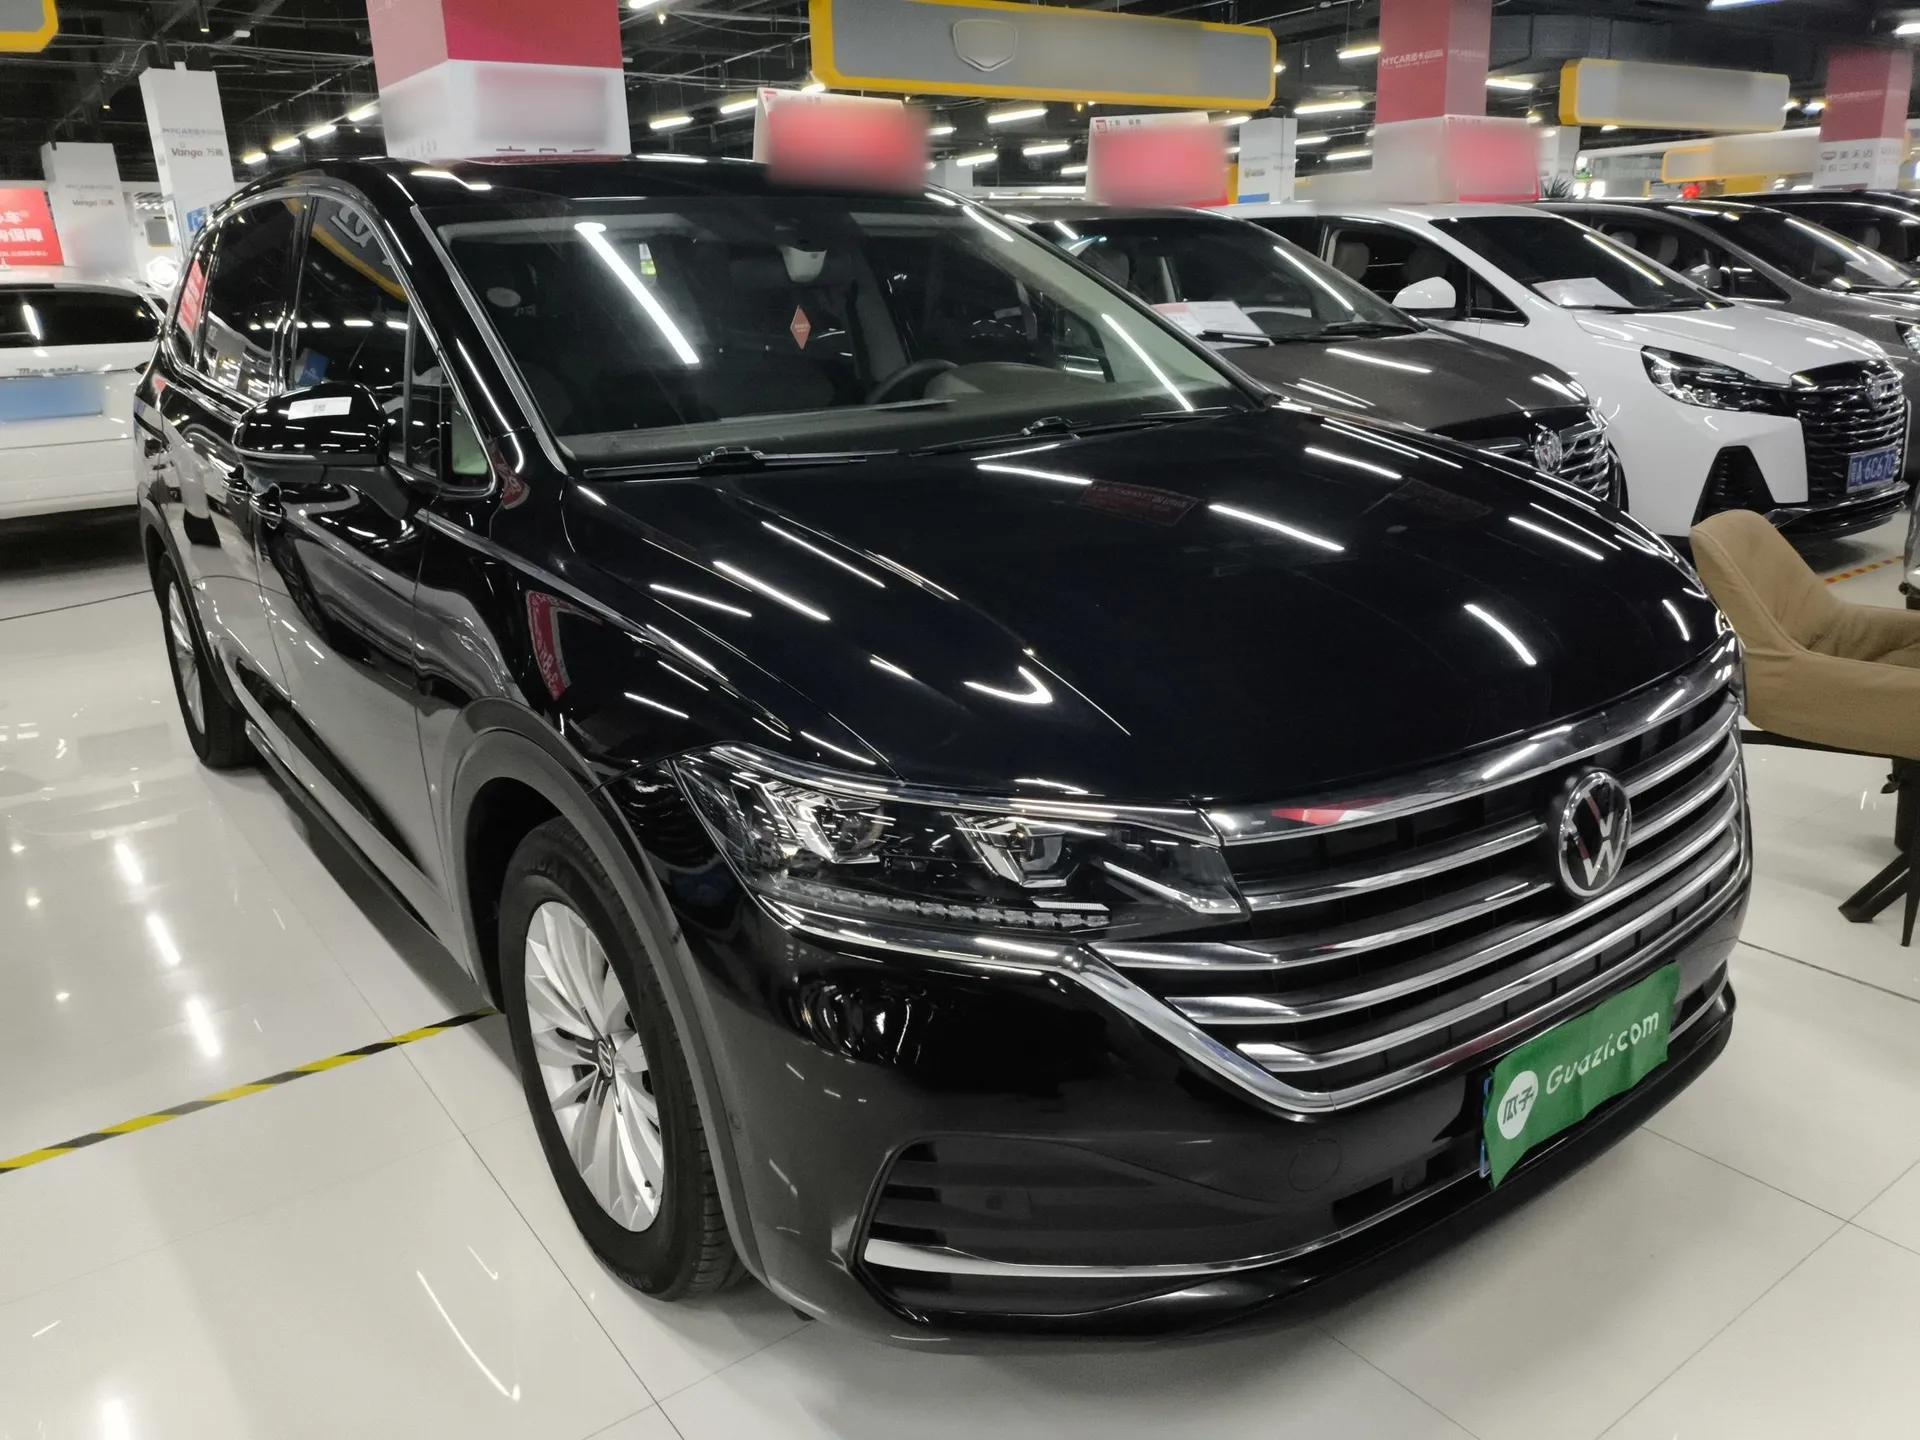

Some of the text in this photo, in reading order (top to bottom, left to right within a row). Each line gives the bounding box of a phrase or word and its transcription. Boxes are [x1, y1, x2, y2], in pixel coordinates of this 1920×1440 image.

[171, 147, 203, 158] Vango
[1502, 1011, 1659, 1125] 瓜子 Guazi.com
